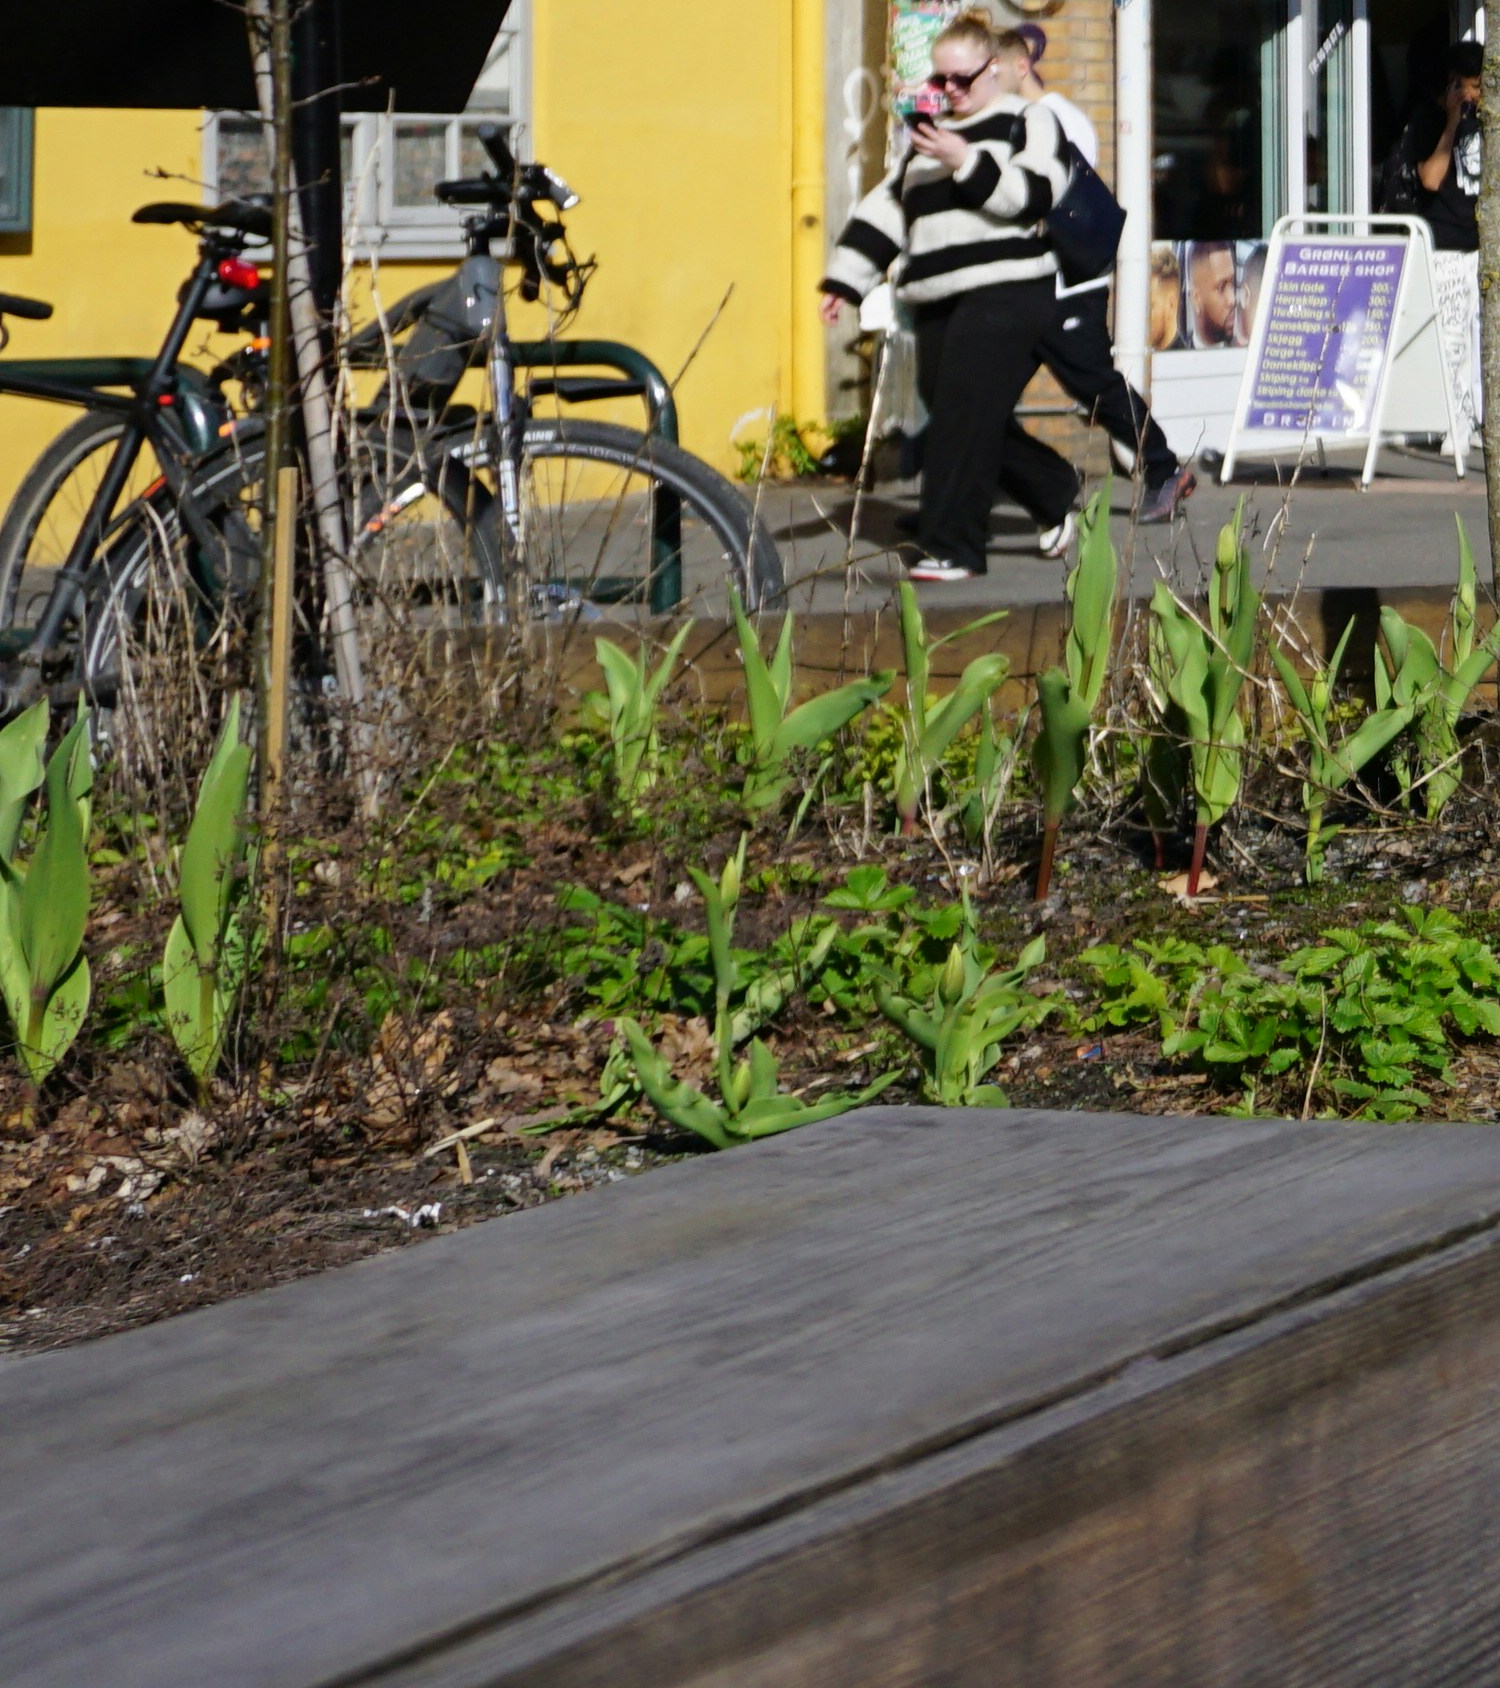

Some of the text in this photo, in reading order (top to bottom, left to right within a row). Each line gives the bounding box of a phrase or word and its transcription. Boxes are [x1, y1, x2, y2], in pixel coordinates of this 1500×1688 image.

[1299, 248, 1386, 261] GRØNLAND
[1284, 262, 1395, 276] BARBER SHOP
[1278, 281, 1298, 292] Skin
[1300, 281, 1325, 292] fade
[1267, 334, 1303, 346] Skjegg
[1265, 346, 1294, 358] Farge
